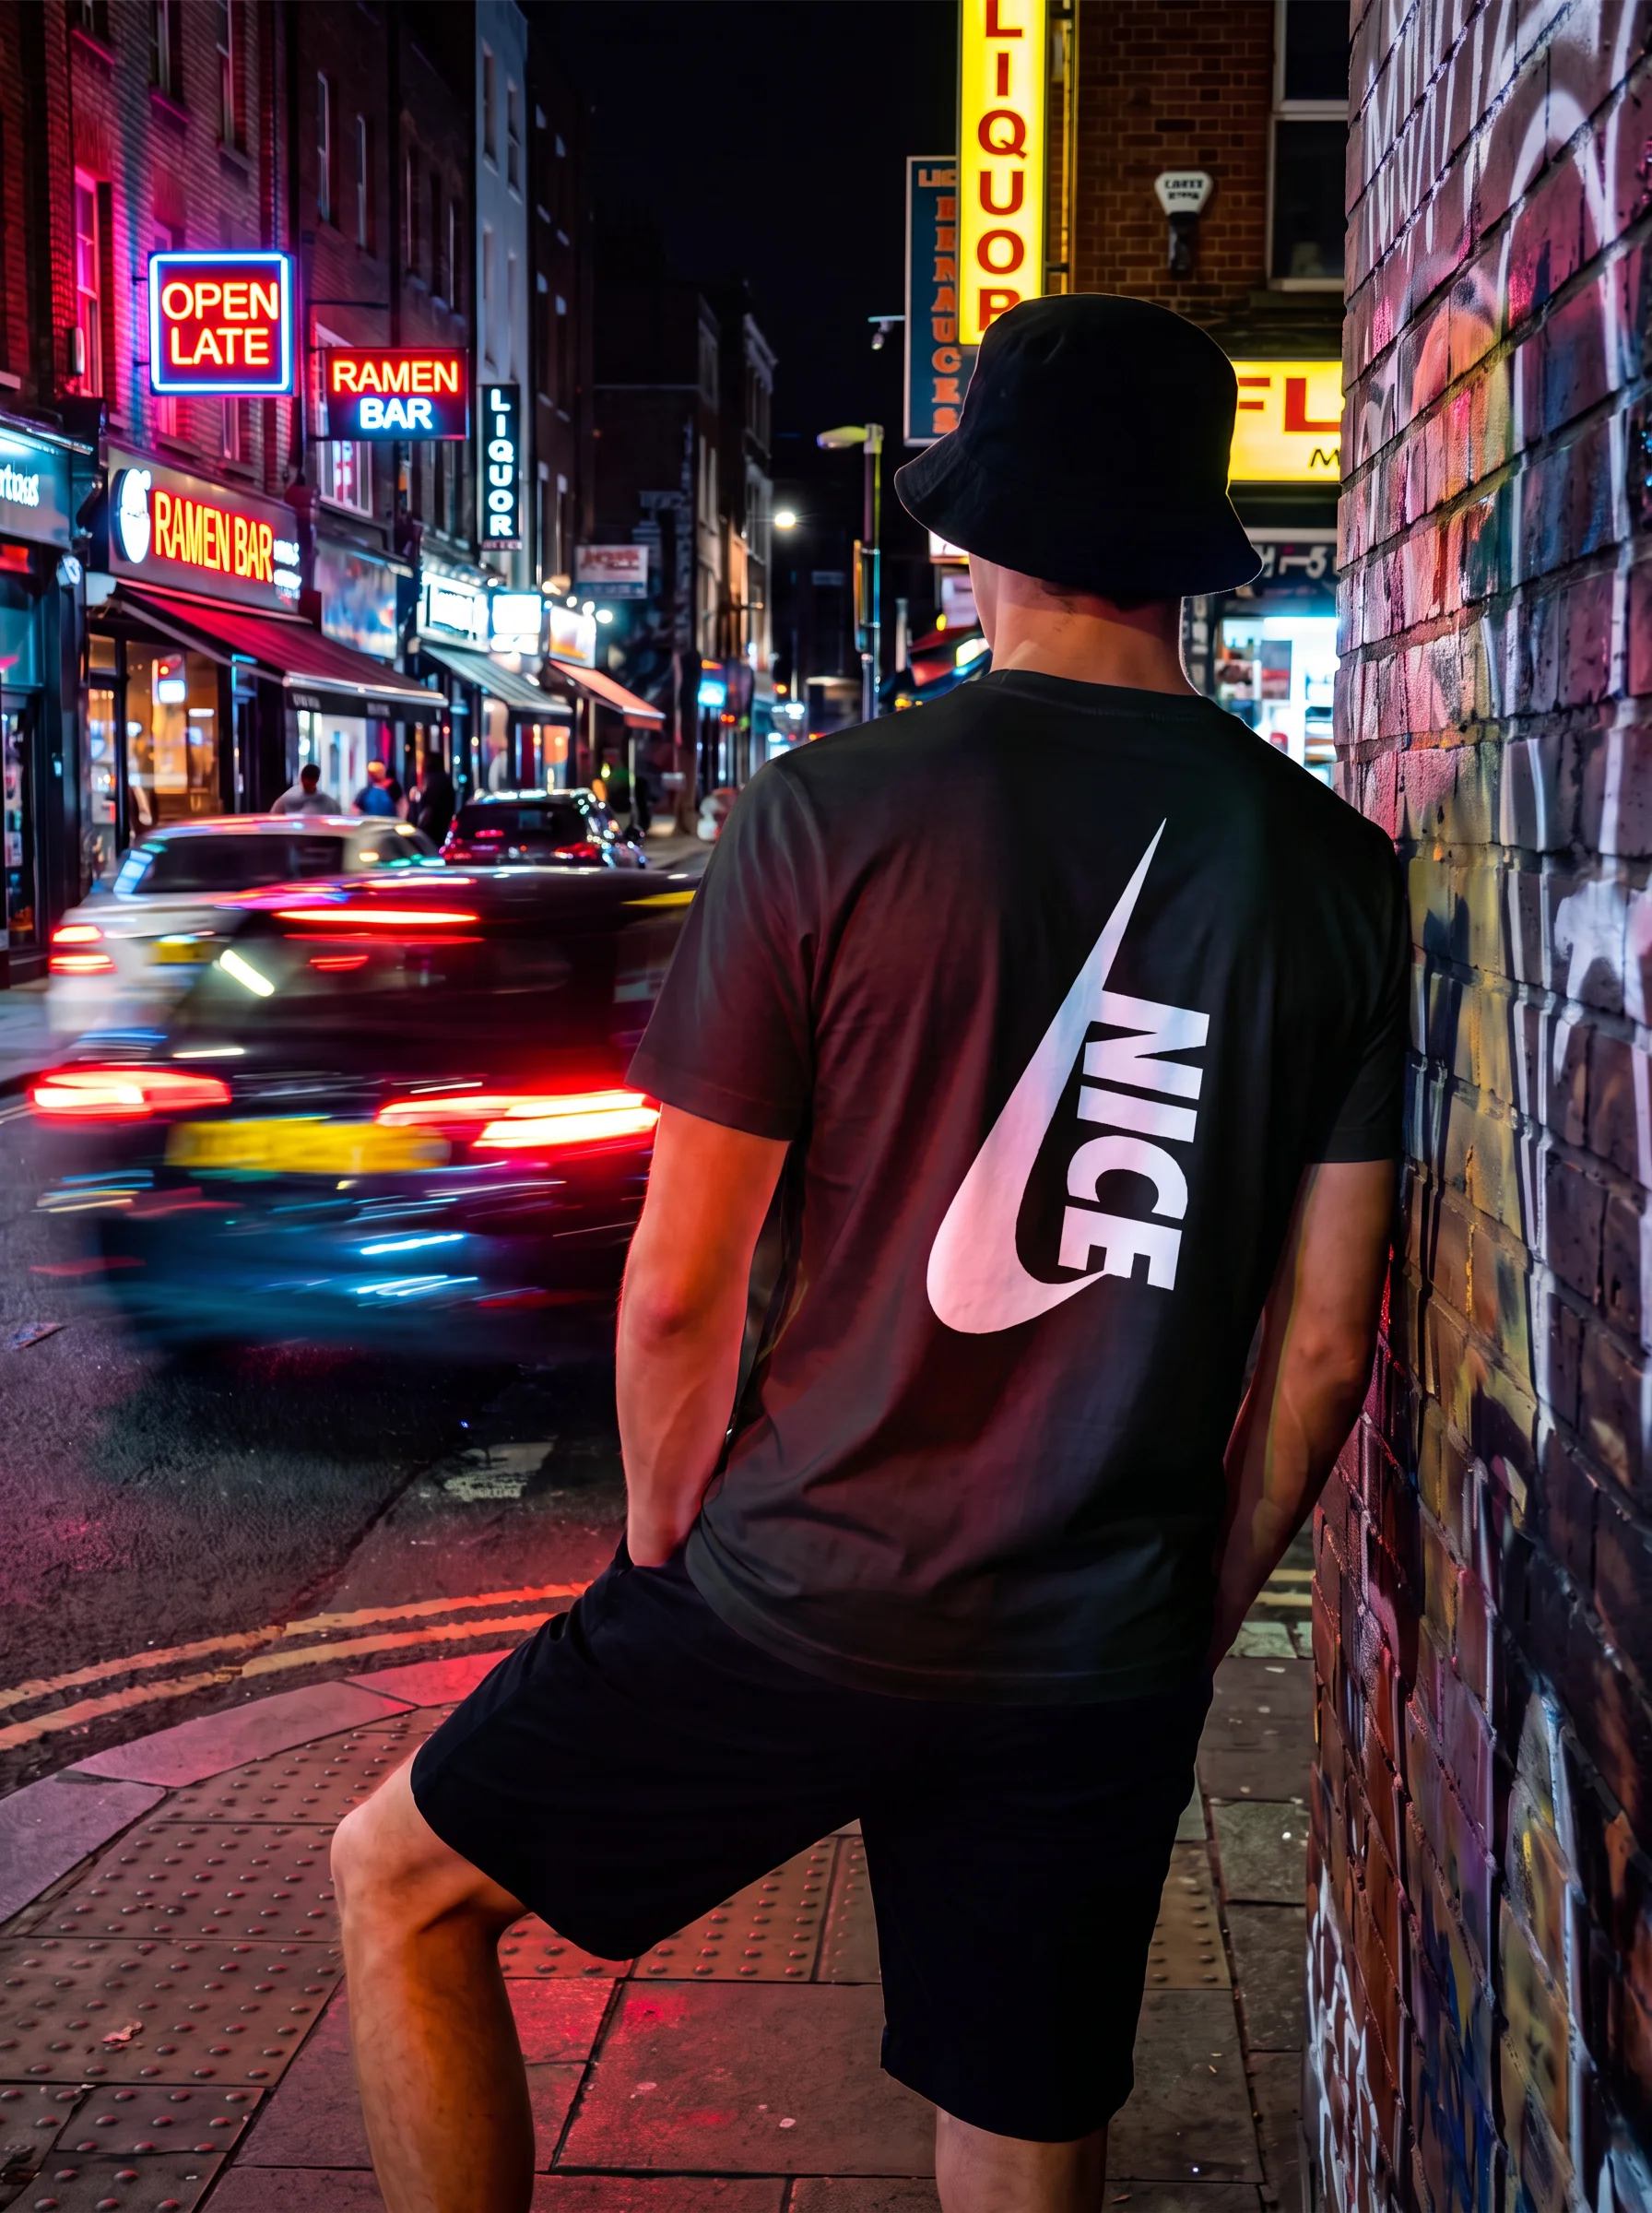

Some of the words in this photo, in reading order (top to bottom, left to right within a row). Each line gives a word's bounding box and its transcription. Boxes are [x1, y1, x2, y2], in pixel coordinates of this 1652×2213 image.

[161, 282, 278, 320] OPEN
[171, 326, 269, 365] LATE
[333, 361, 458, 393] RAMEN
[360, 397, 433, 429] BAR
[488, 388, 514, 536] LIQUOR
[155, 491, 230, 573] RAMEN
[234, 516, 273, 583] BAR
[1057, 990, 1210, 1291] NICE
